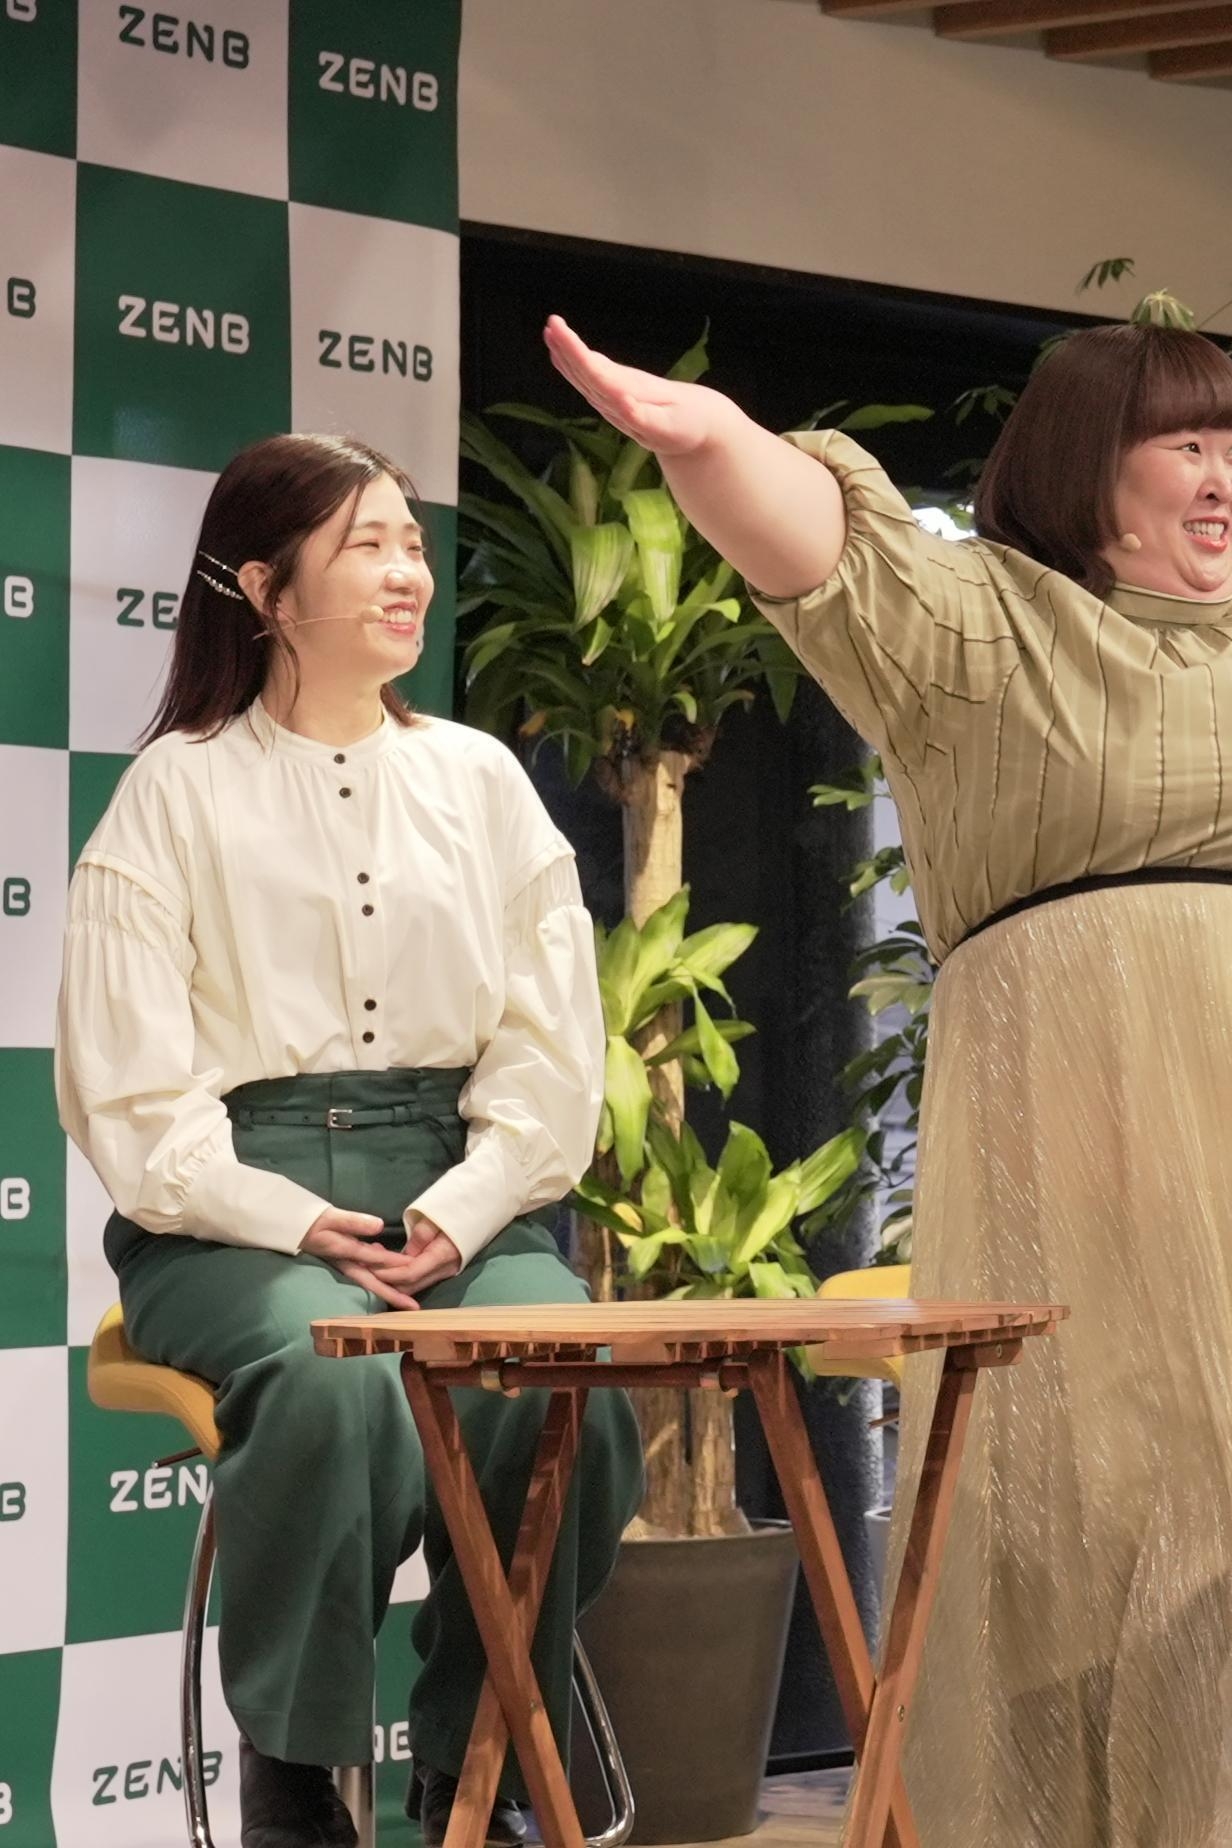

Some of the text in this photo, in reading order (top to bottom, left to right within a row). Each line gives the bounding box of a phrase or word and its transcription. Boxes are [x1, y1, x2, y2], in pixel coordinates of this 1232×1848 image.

[119, 5, 249, 69] ZENB
[318, 51, 438, 112] ZENB
[118, 294, 249, 354] ZENB
[318, 330, 433, 382] ZENB
[117, 588, 179, 630] ZE
[110, 1464, 208, 1512] ZEN
